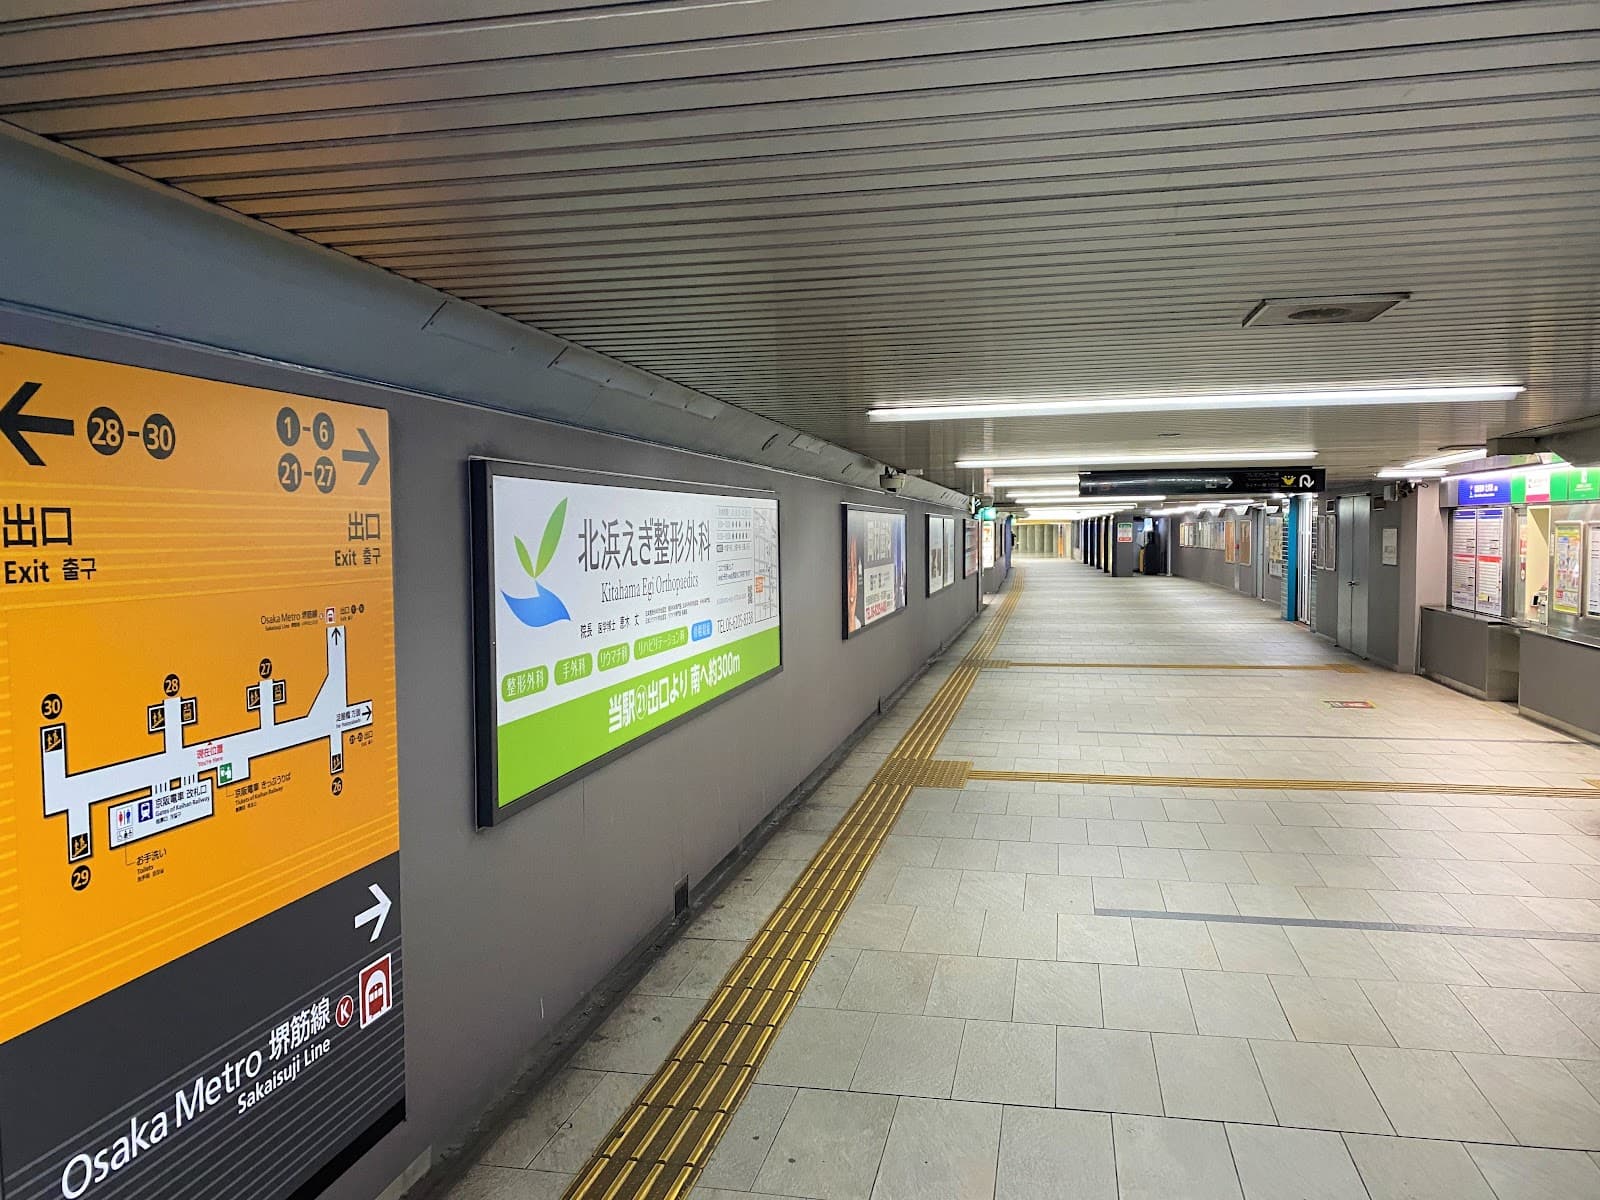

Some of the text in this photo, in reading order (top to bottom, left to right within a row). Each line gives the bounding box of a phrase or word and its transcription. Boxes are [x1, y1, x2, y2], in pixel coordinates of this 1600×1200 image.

[2, 504, 72, 548] 出口
[348, 511, 381, 541] 出口
[578, 517, 710, 572] 北浜えぎ整形外科
[334, 547, 381, 568] Exit 출구
[4, 558, 97, 584] Exit 출구
[601, 570, 699, 603] Kitahama Egi Orthopaedics
[281, 612, 300, 622] Metro
[638, 630, 685, 652] リハビリテーション科
[600, 646, 628, 668] リウマチ科
[260, 660, 272, 678] 27
[563, 658, 586, 680] 手外科
[164, 676, 179, 695] 28
[506, 670, 544, 697] 整形外科
[43, 696, 61, 717] 30
[155, 784, 207, 809] 京阪電車 改札口
[332, 778, 342, 795] 26
[136, 848, 166, 865] お手洗い
[72, 867, 89, 889] 29
[237, 1038, 331, 1114] Sakaisuji Line
[61, 997, 352, 1200] Osaka Metro 堺筋線 K
